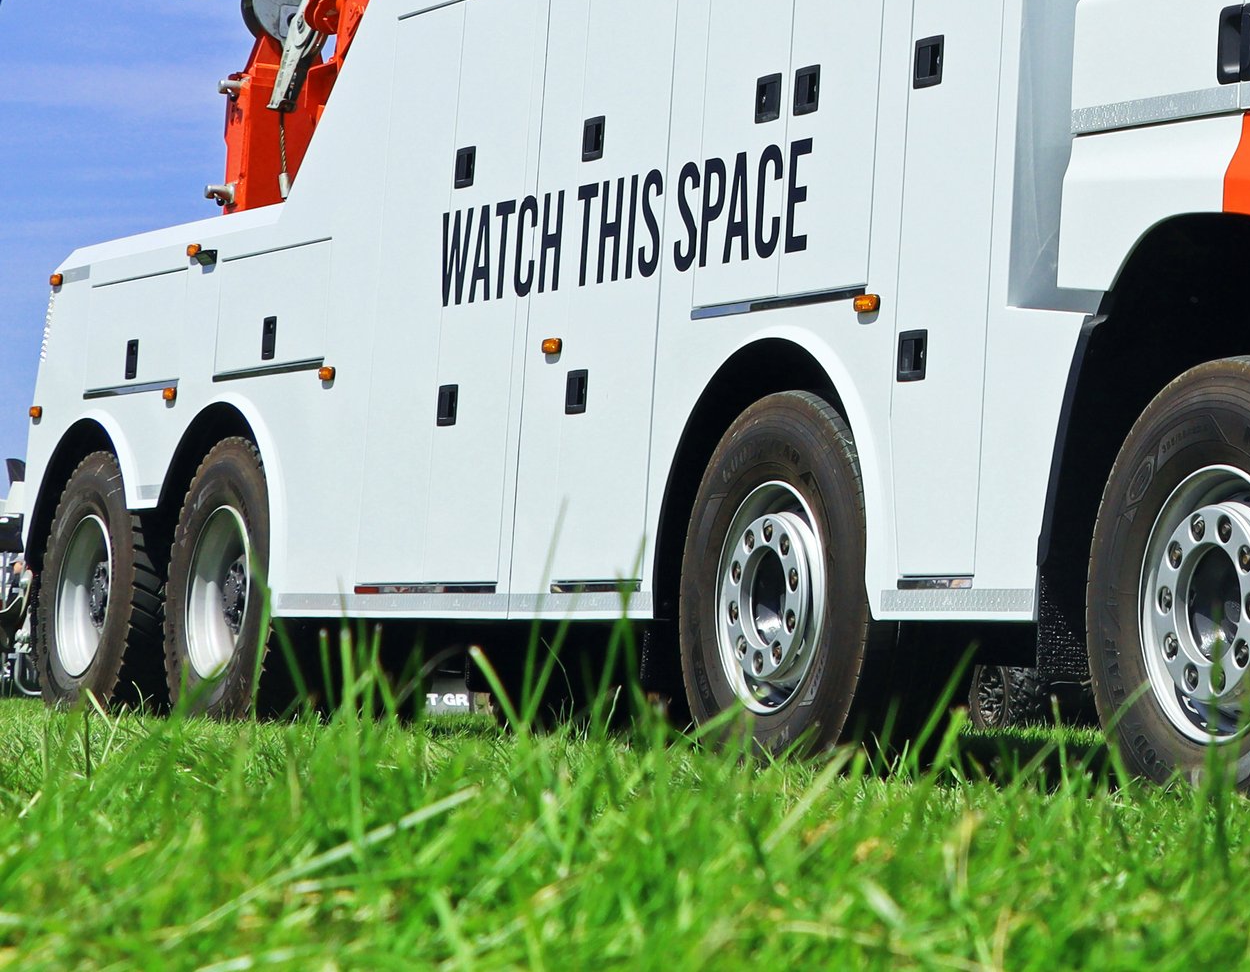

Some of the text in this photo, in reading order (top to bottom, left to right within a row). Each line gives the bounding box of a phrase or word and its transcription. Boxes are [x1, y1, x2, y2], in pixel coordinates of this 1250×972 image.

[441, 137, 813, 307] WATCH THIS SPACE
